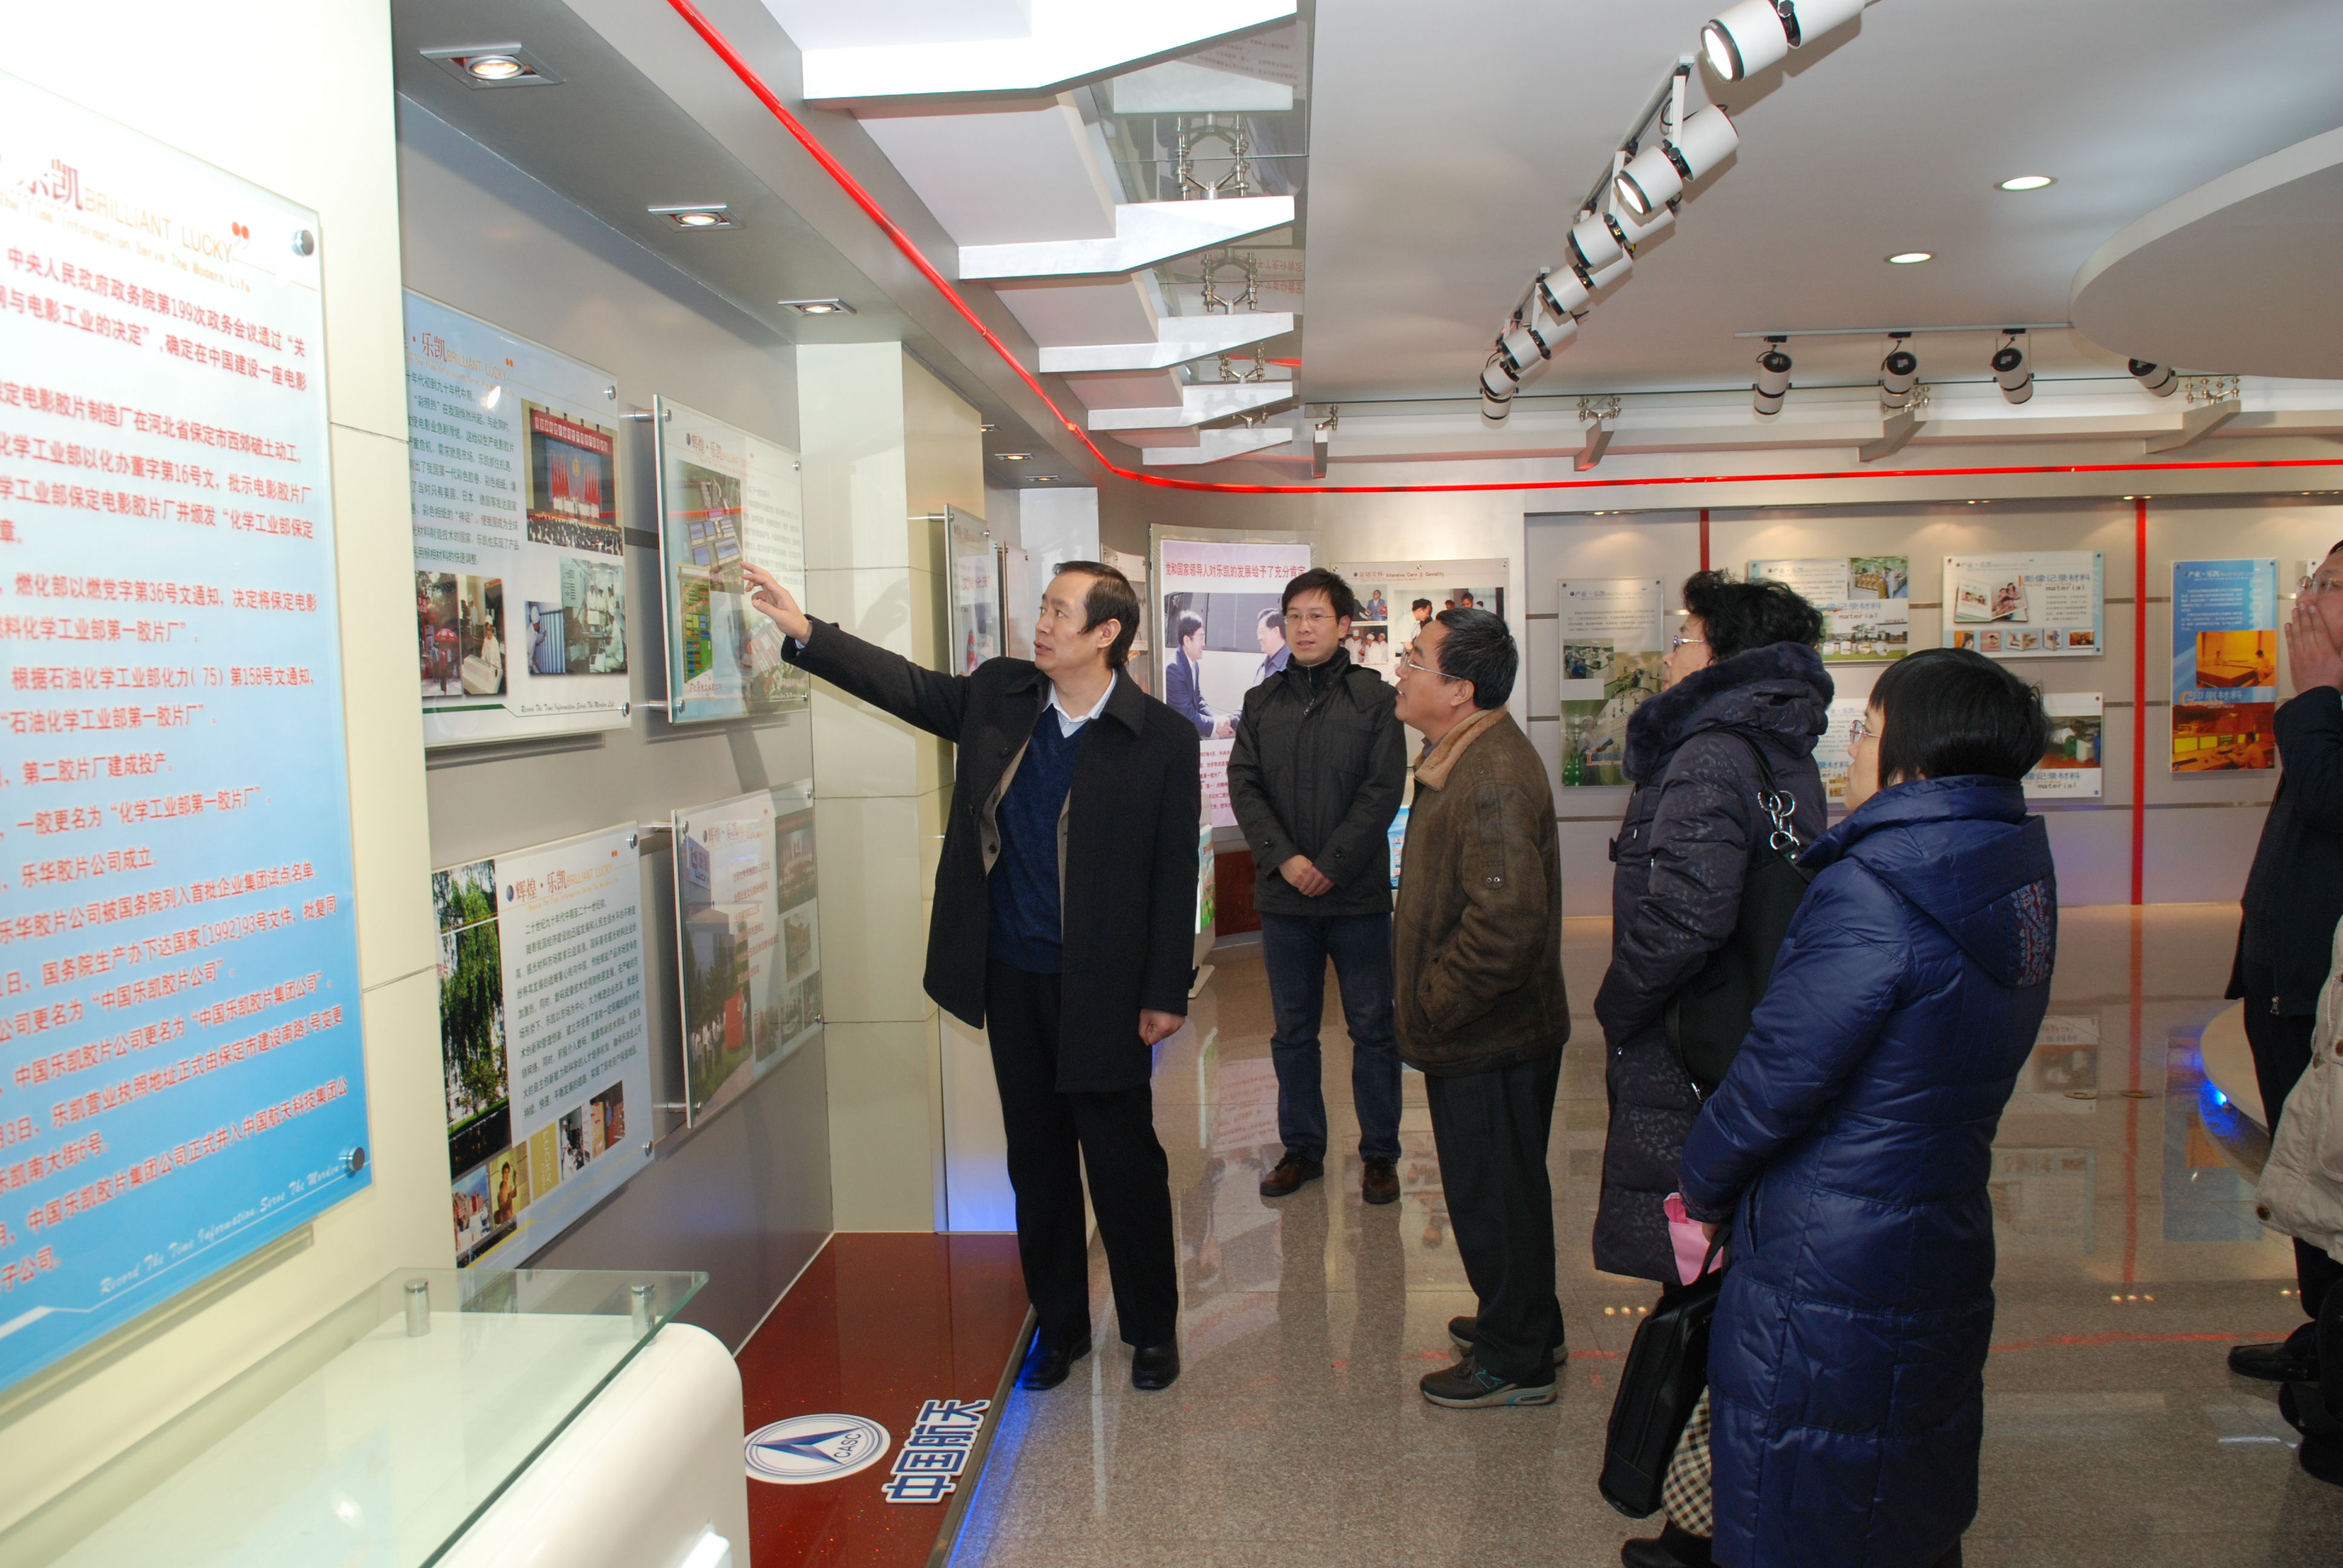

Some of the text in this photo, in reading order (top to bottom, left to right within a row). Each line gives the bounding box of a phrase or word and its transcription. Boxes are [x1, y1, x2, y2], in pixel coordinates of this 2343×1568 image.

[84, 187, 172, 240] BRILLIANT
[182, 226, 232, 264] LUCKY
[171, 252, 188, 271] The
[192, 261, 226, 284] Modern
[228, 275, 252, 293] Life
[0, 380, 302, 463] 定电影胶片制造厂在河北省保定市西郊破土动工。
[143, 1250, 165, 1270] The
[834, 1432, 862, 1459] CASC
